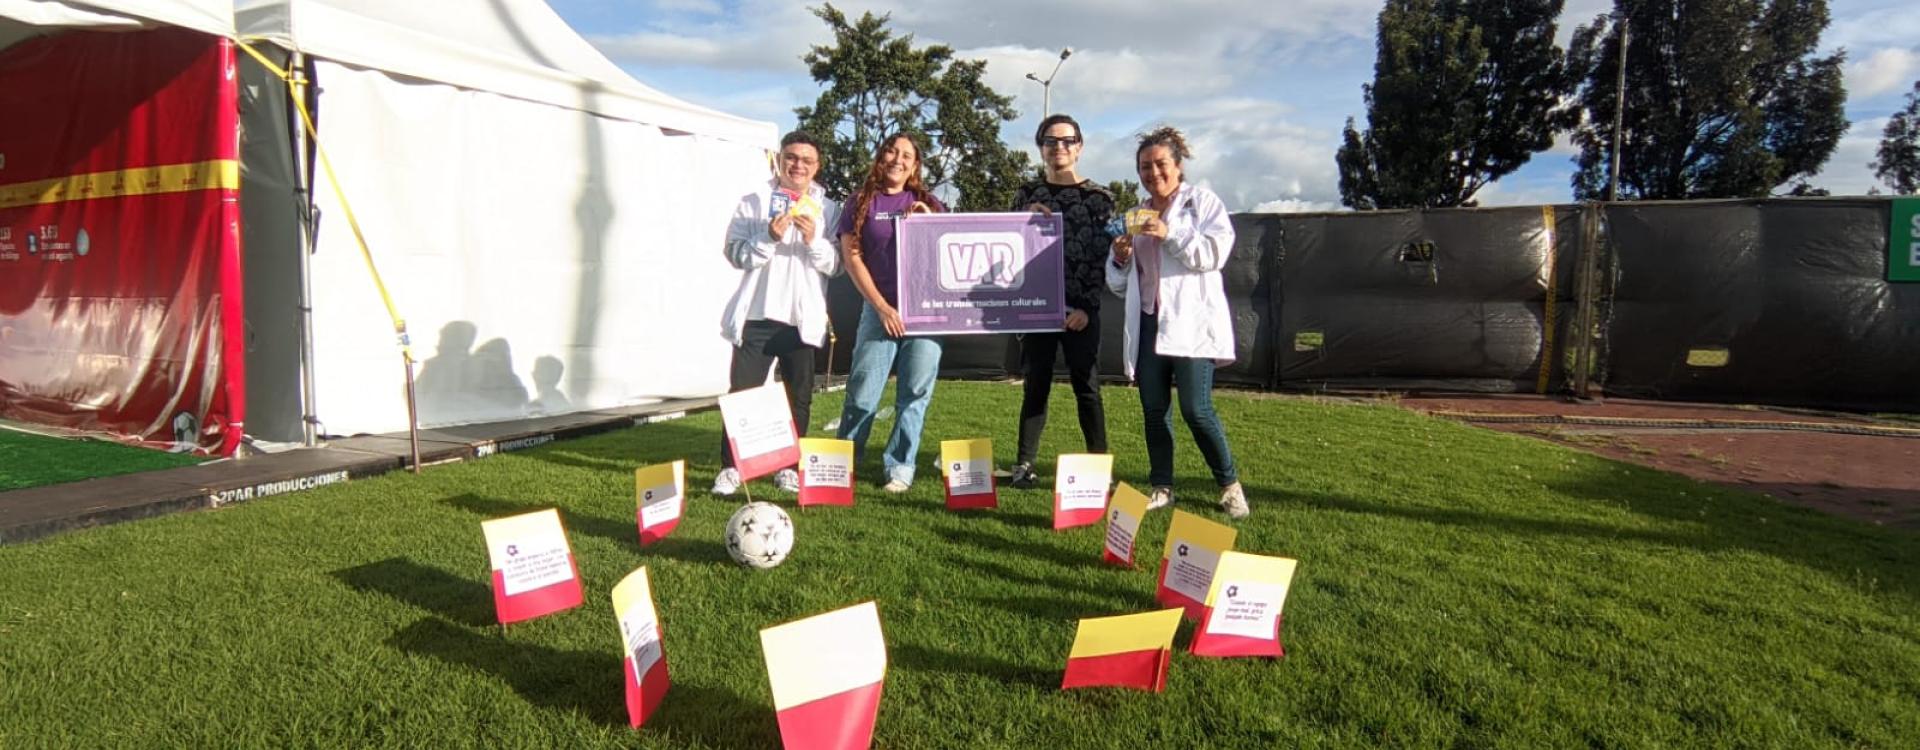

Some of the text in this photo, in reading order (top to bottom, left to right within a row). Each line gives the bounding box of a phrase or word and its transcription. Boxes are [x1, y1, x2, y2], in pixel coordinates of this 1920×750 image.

[947, 242, 1015, 285] VAR
[1011, 297, 1047, 307] culturales
[257, 470, 349, 498] PRODUCCIONES
